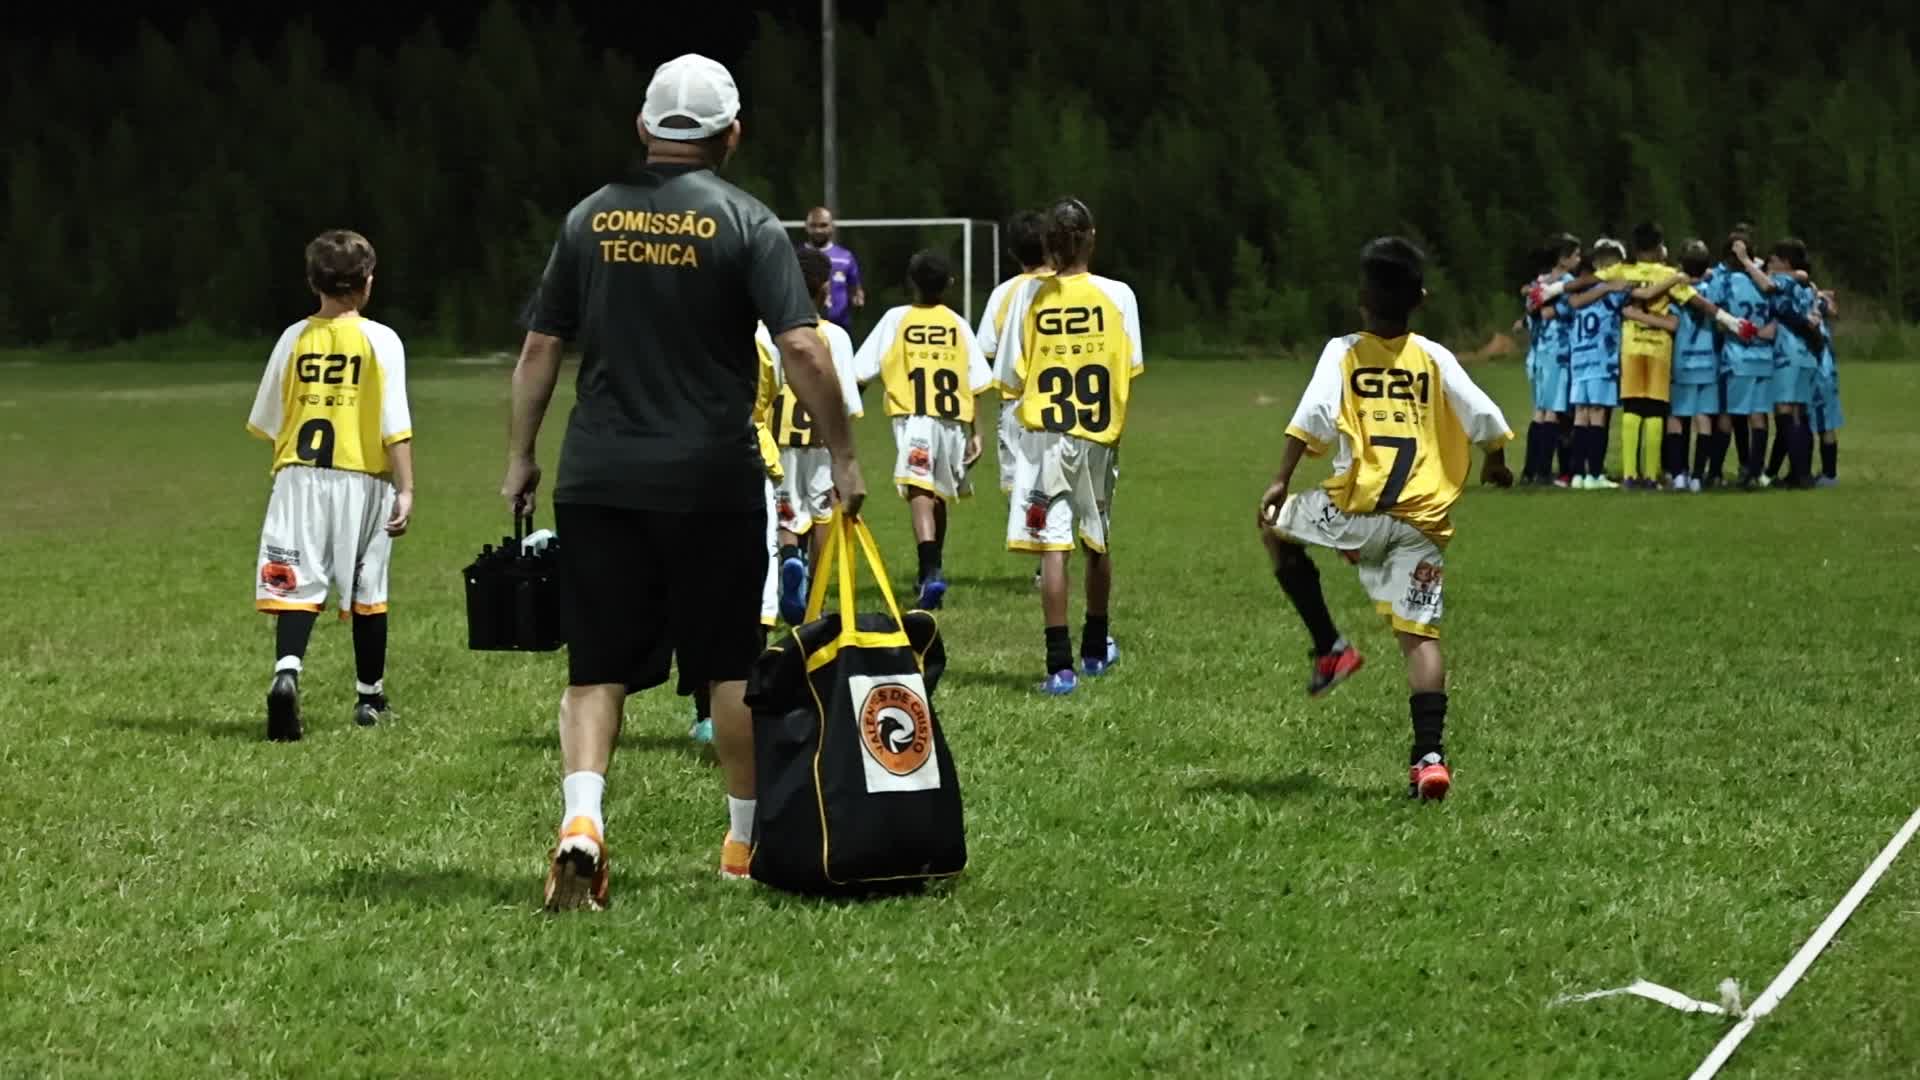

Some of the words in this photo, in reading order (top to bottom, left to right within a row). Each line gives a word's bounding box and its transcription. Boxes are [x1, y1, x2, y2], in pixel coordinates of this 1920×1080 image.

[592, 209, 717, 239] COMISSÃO
[600, 233, 698, 268] TÉCNICA
[905, 324, 957, 347] G21
[1036, 306, 1105, 335] G21
[296, 353, 362, 385] G21
[1351, 367, 1429, 404] G21
[908, 367, 961, 419] 18
[1037, 364, 1111, 434] 39
[296, 418, 335, 469] 9
[1369, 436, 1418, 513] 7
[891, 689, 911, 704] DE
[911, 701, 928, 753] CRISTO
